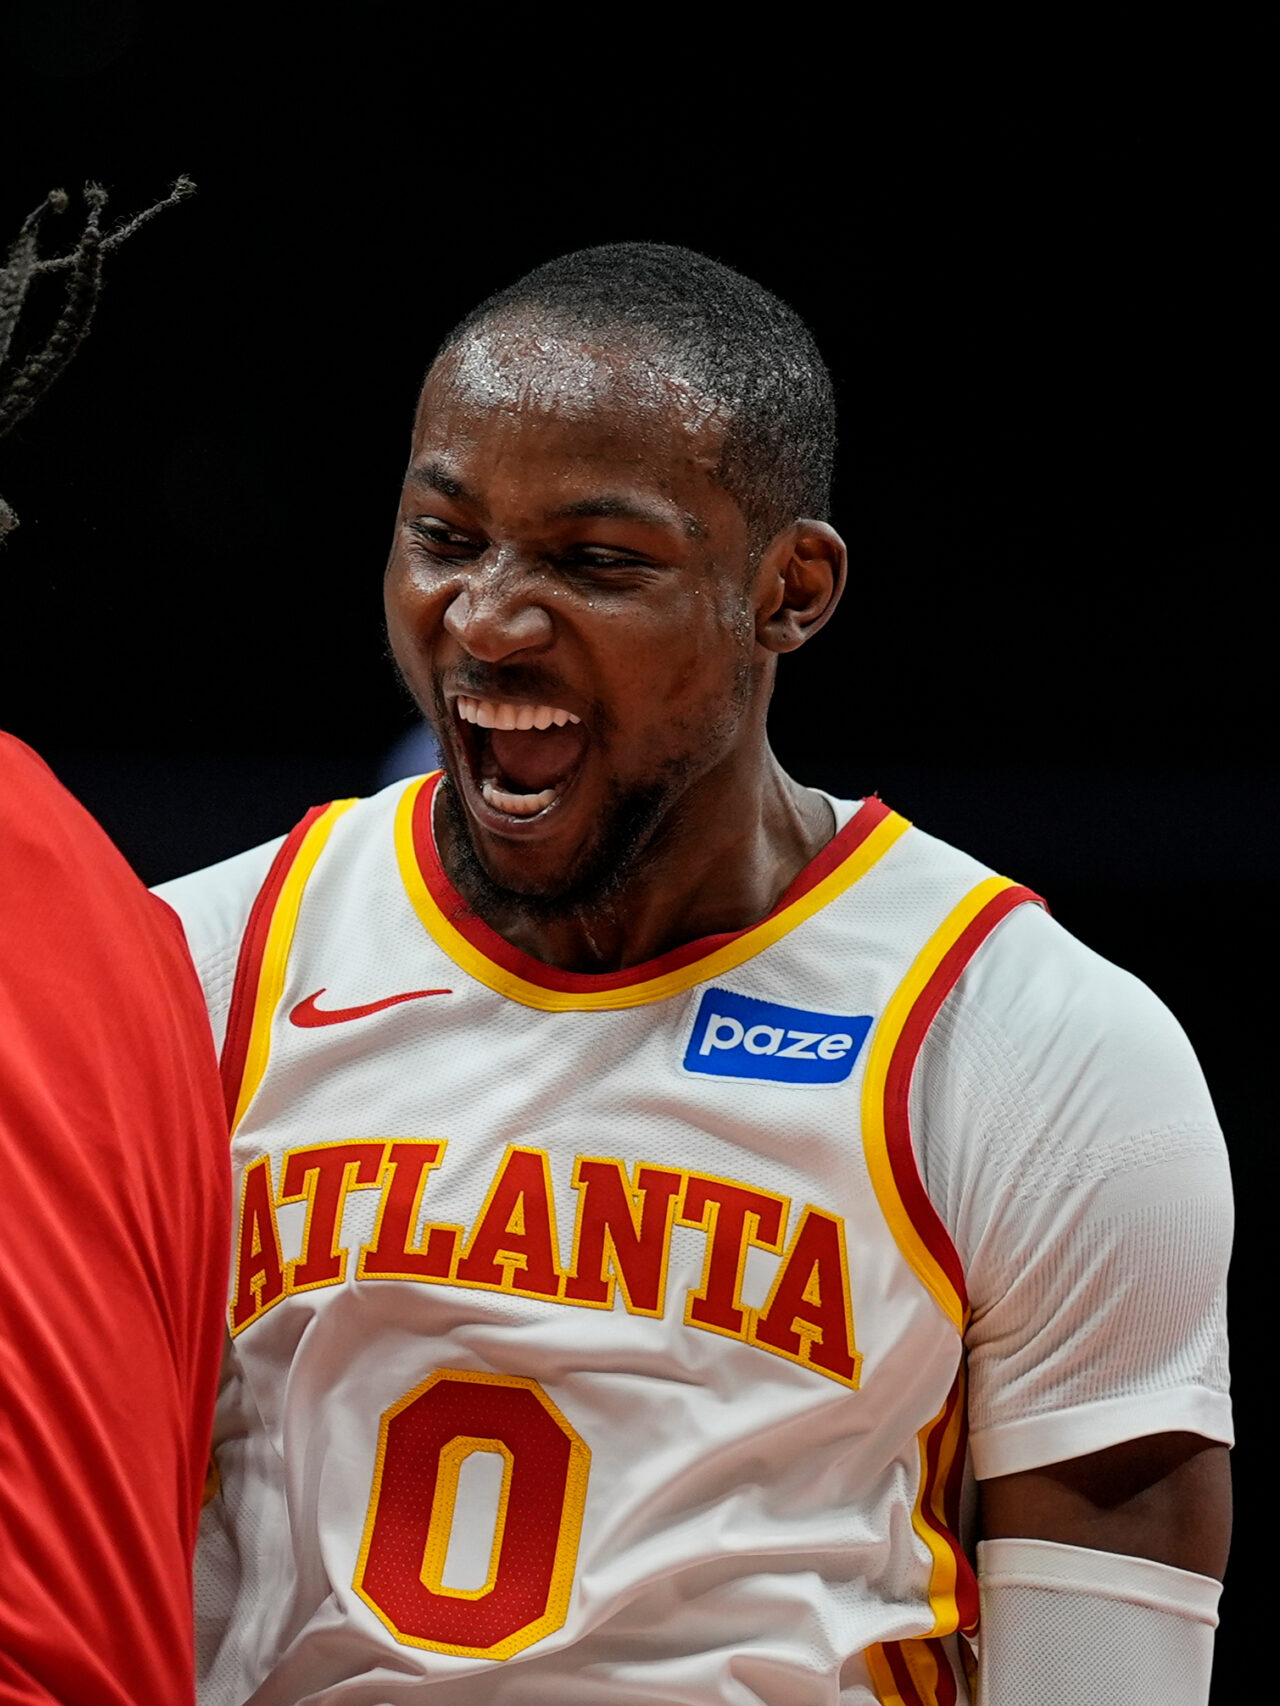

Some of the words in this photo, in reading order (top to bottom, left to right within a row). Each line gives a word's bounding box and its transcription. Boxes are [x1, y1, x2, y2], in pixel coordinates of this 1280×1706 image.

[699, 1013, 853, 1060] paze
[229, 1138, 864, 1390] ATLANTA
[351, 1369, 592, 1661] 0
